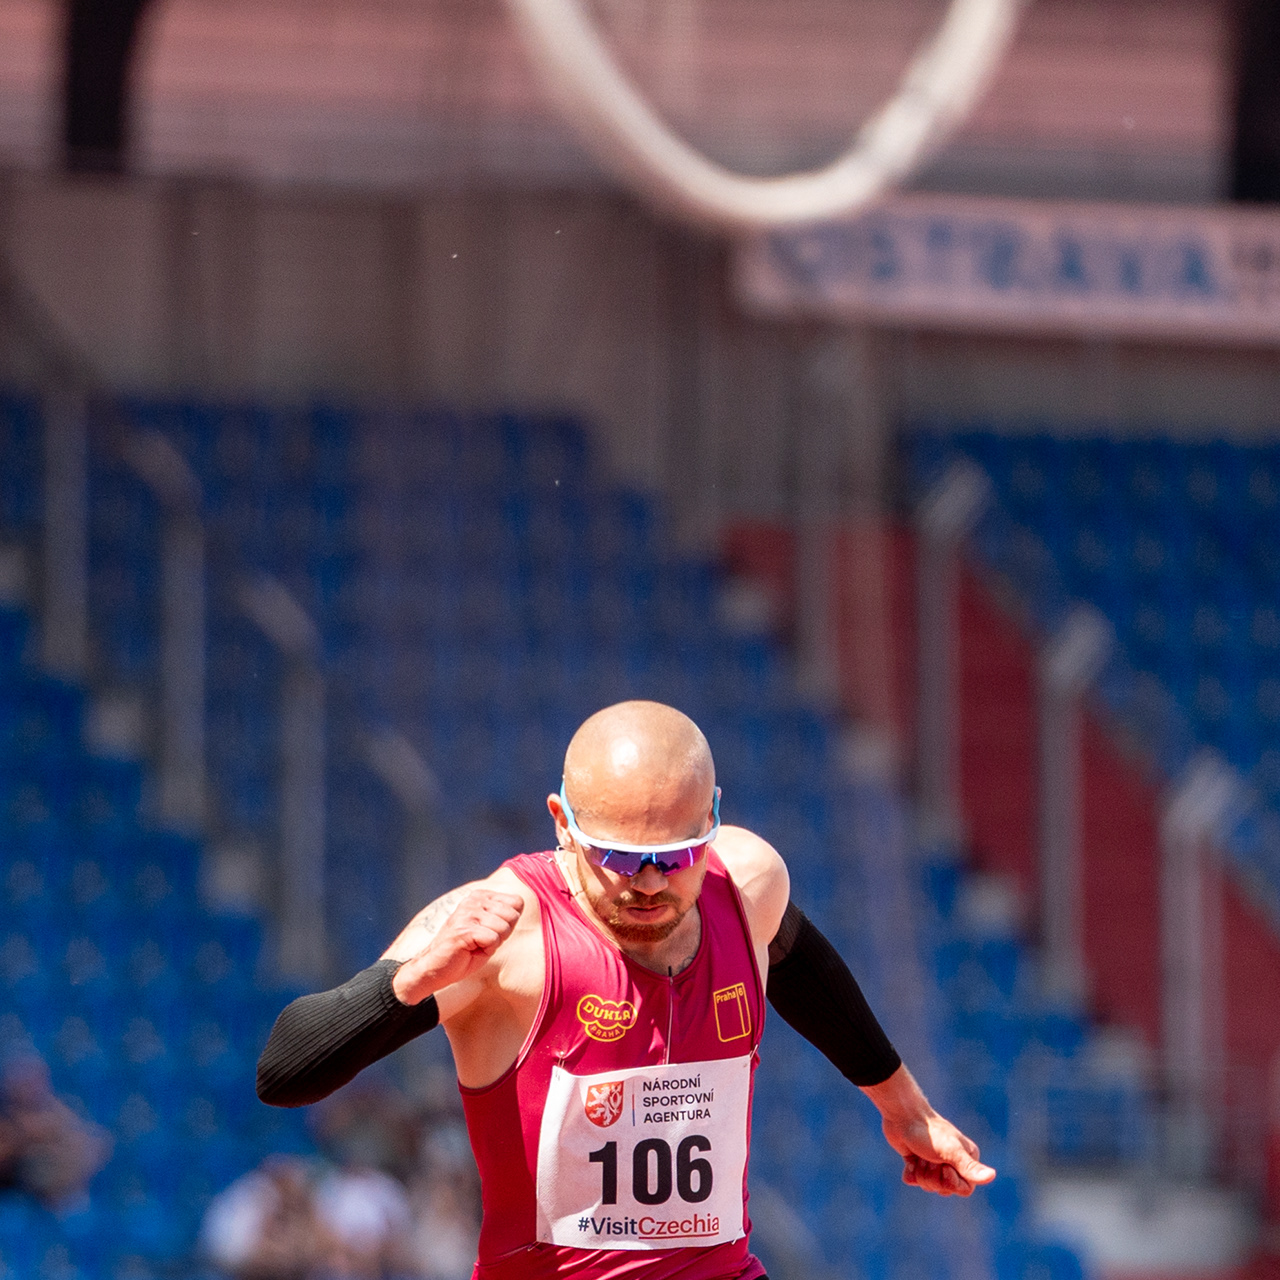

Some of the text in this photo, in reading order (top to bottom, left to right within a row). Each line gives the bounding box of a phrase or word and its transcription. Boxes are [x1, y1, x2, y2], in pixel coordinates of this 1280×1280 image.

[716, 987, 745, 1004] Praha 6
[590, 1025, 621, 1038] PRAHA
[642, 1073, 702, 1092] NÁRODNÍ
[642, 1088, 715, 1108] SPORTOVNÍ
[643, 1107, 712, 1124] AGENTURA
[588, 1134, 714, 1206] 106
[578, 1213, 720, 1236] #VisitCzechia
